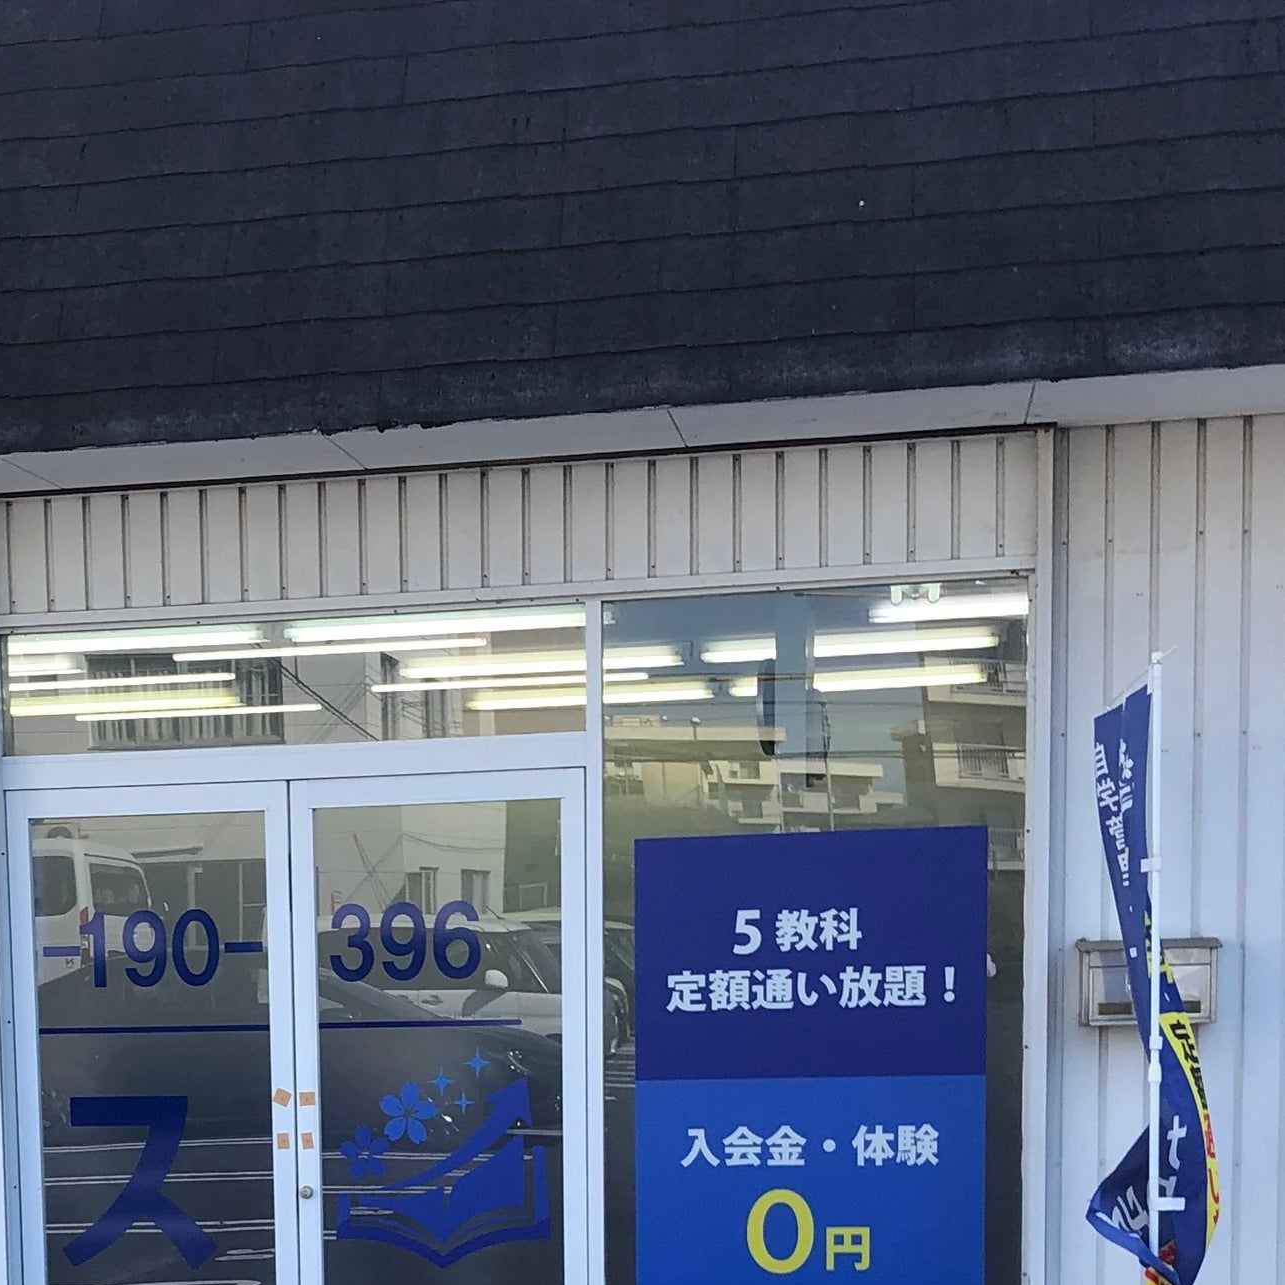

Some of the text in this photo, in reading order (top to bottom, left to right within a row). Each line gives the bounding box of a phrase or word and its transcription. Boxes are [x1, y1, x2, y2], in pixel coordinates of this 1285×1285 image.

[733, 907, 863, 955] 5教科
[666, 965, 957, 1013] 定額通い放題！
[680, 1124, 939, 1168] 入会金・体験
[746, 1188, 871, 1274] 0円
